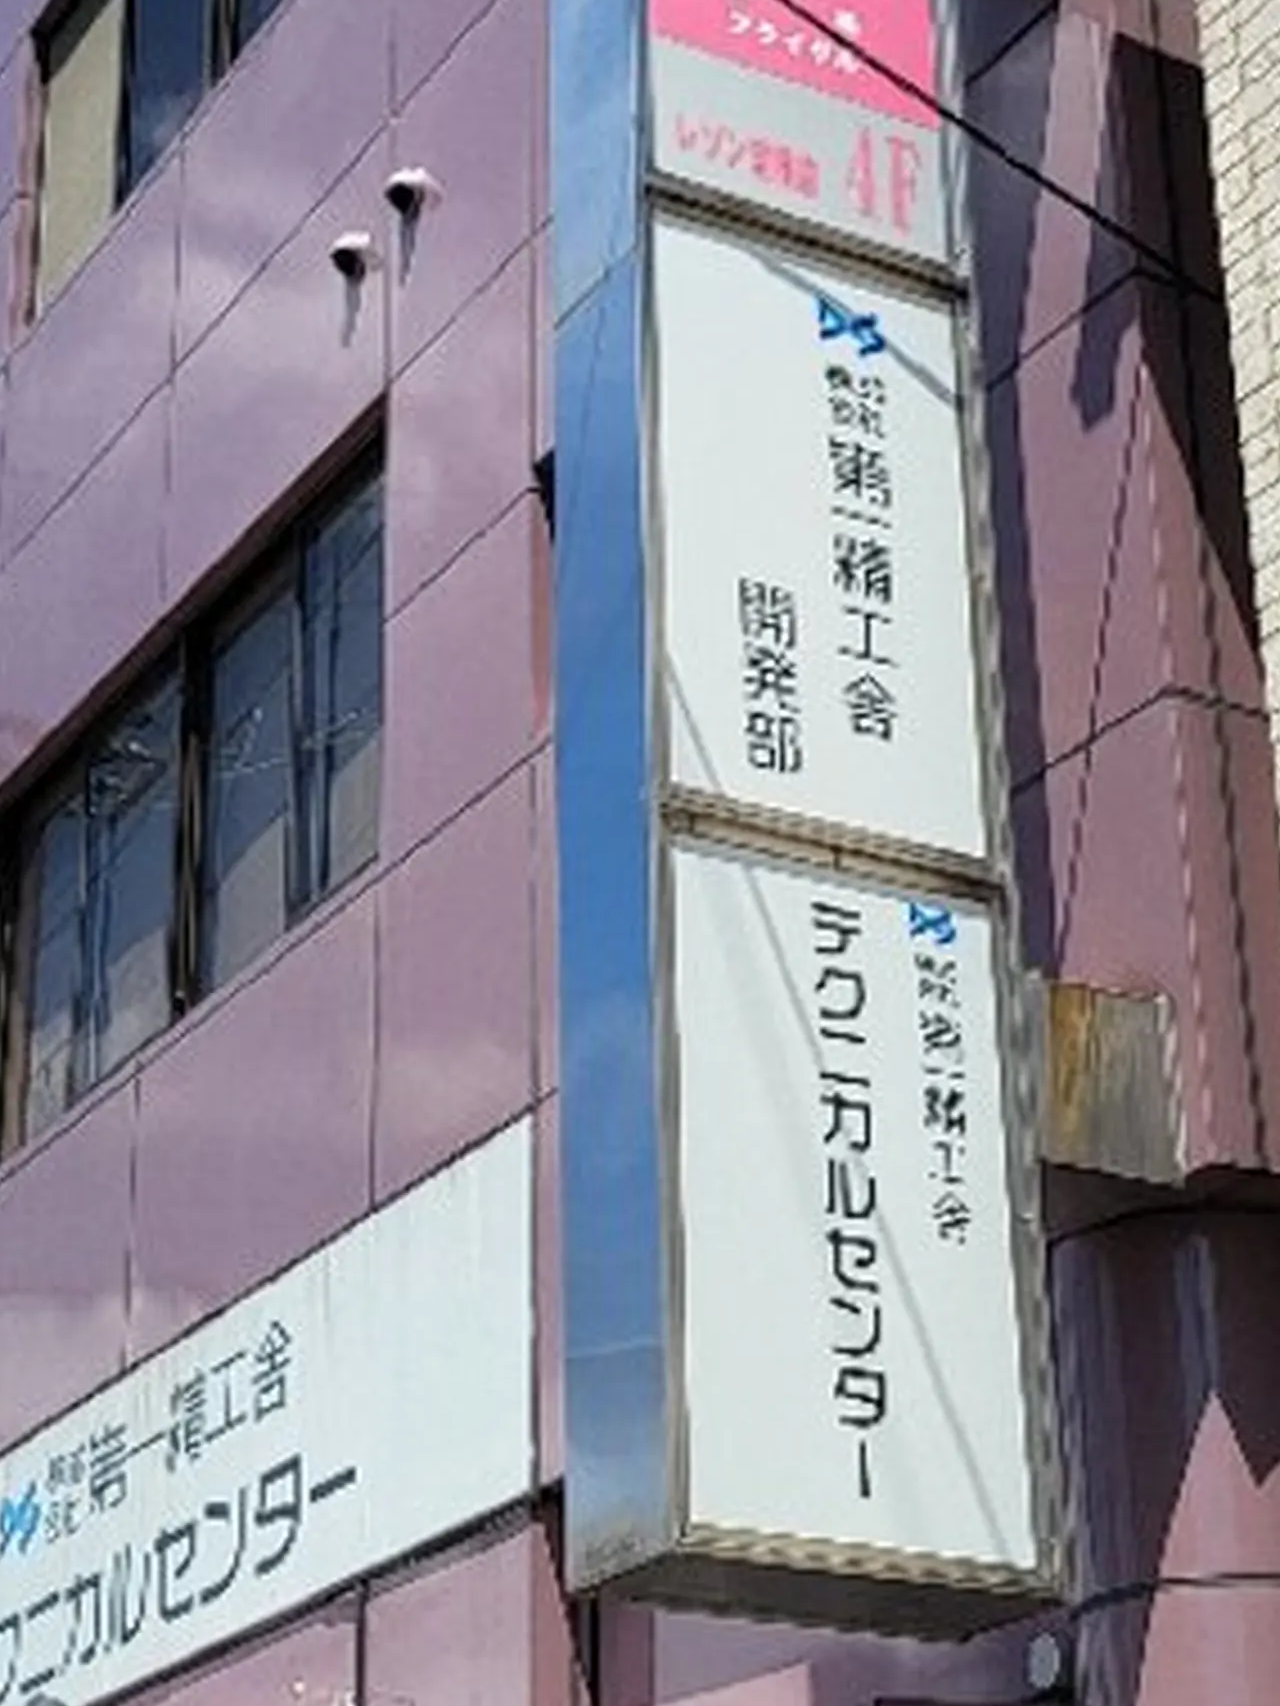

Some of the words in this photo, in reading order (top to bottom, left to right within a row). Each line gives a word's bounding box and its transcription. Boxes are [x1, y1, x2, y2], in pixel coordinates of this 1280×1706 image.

[811, 899, 888, 1499] テクニカルセンター
